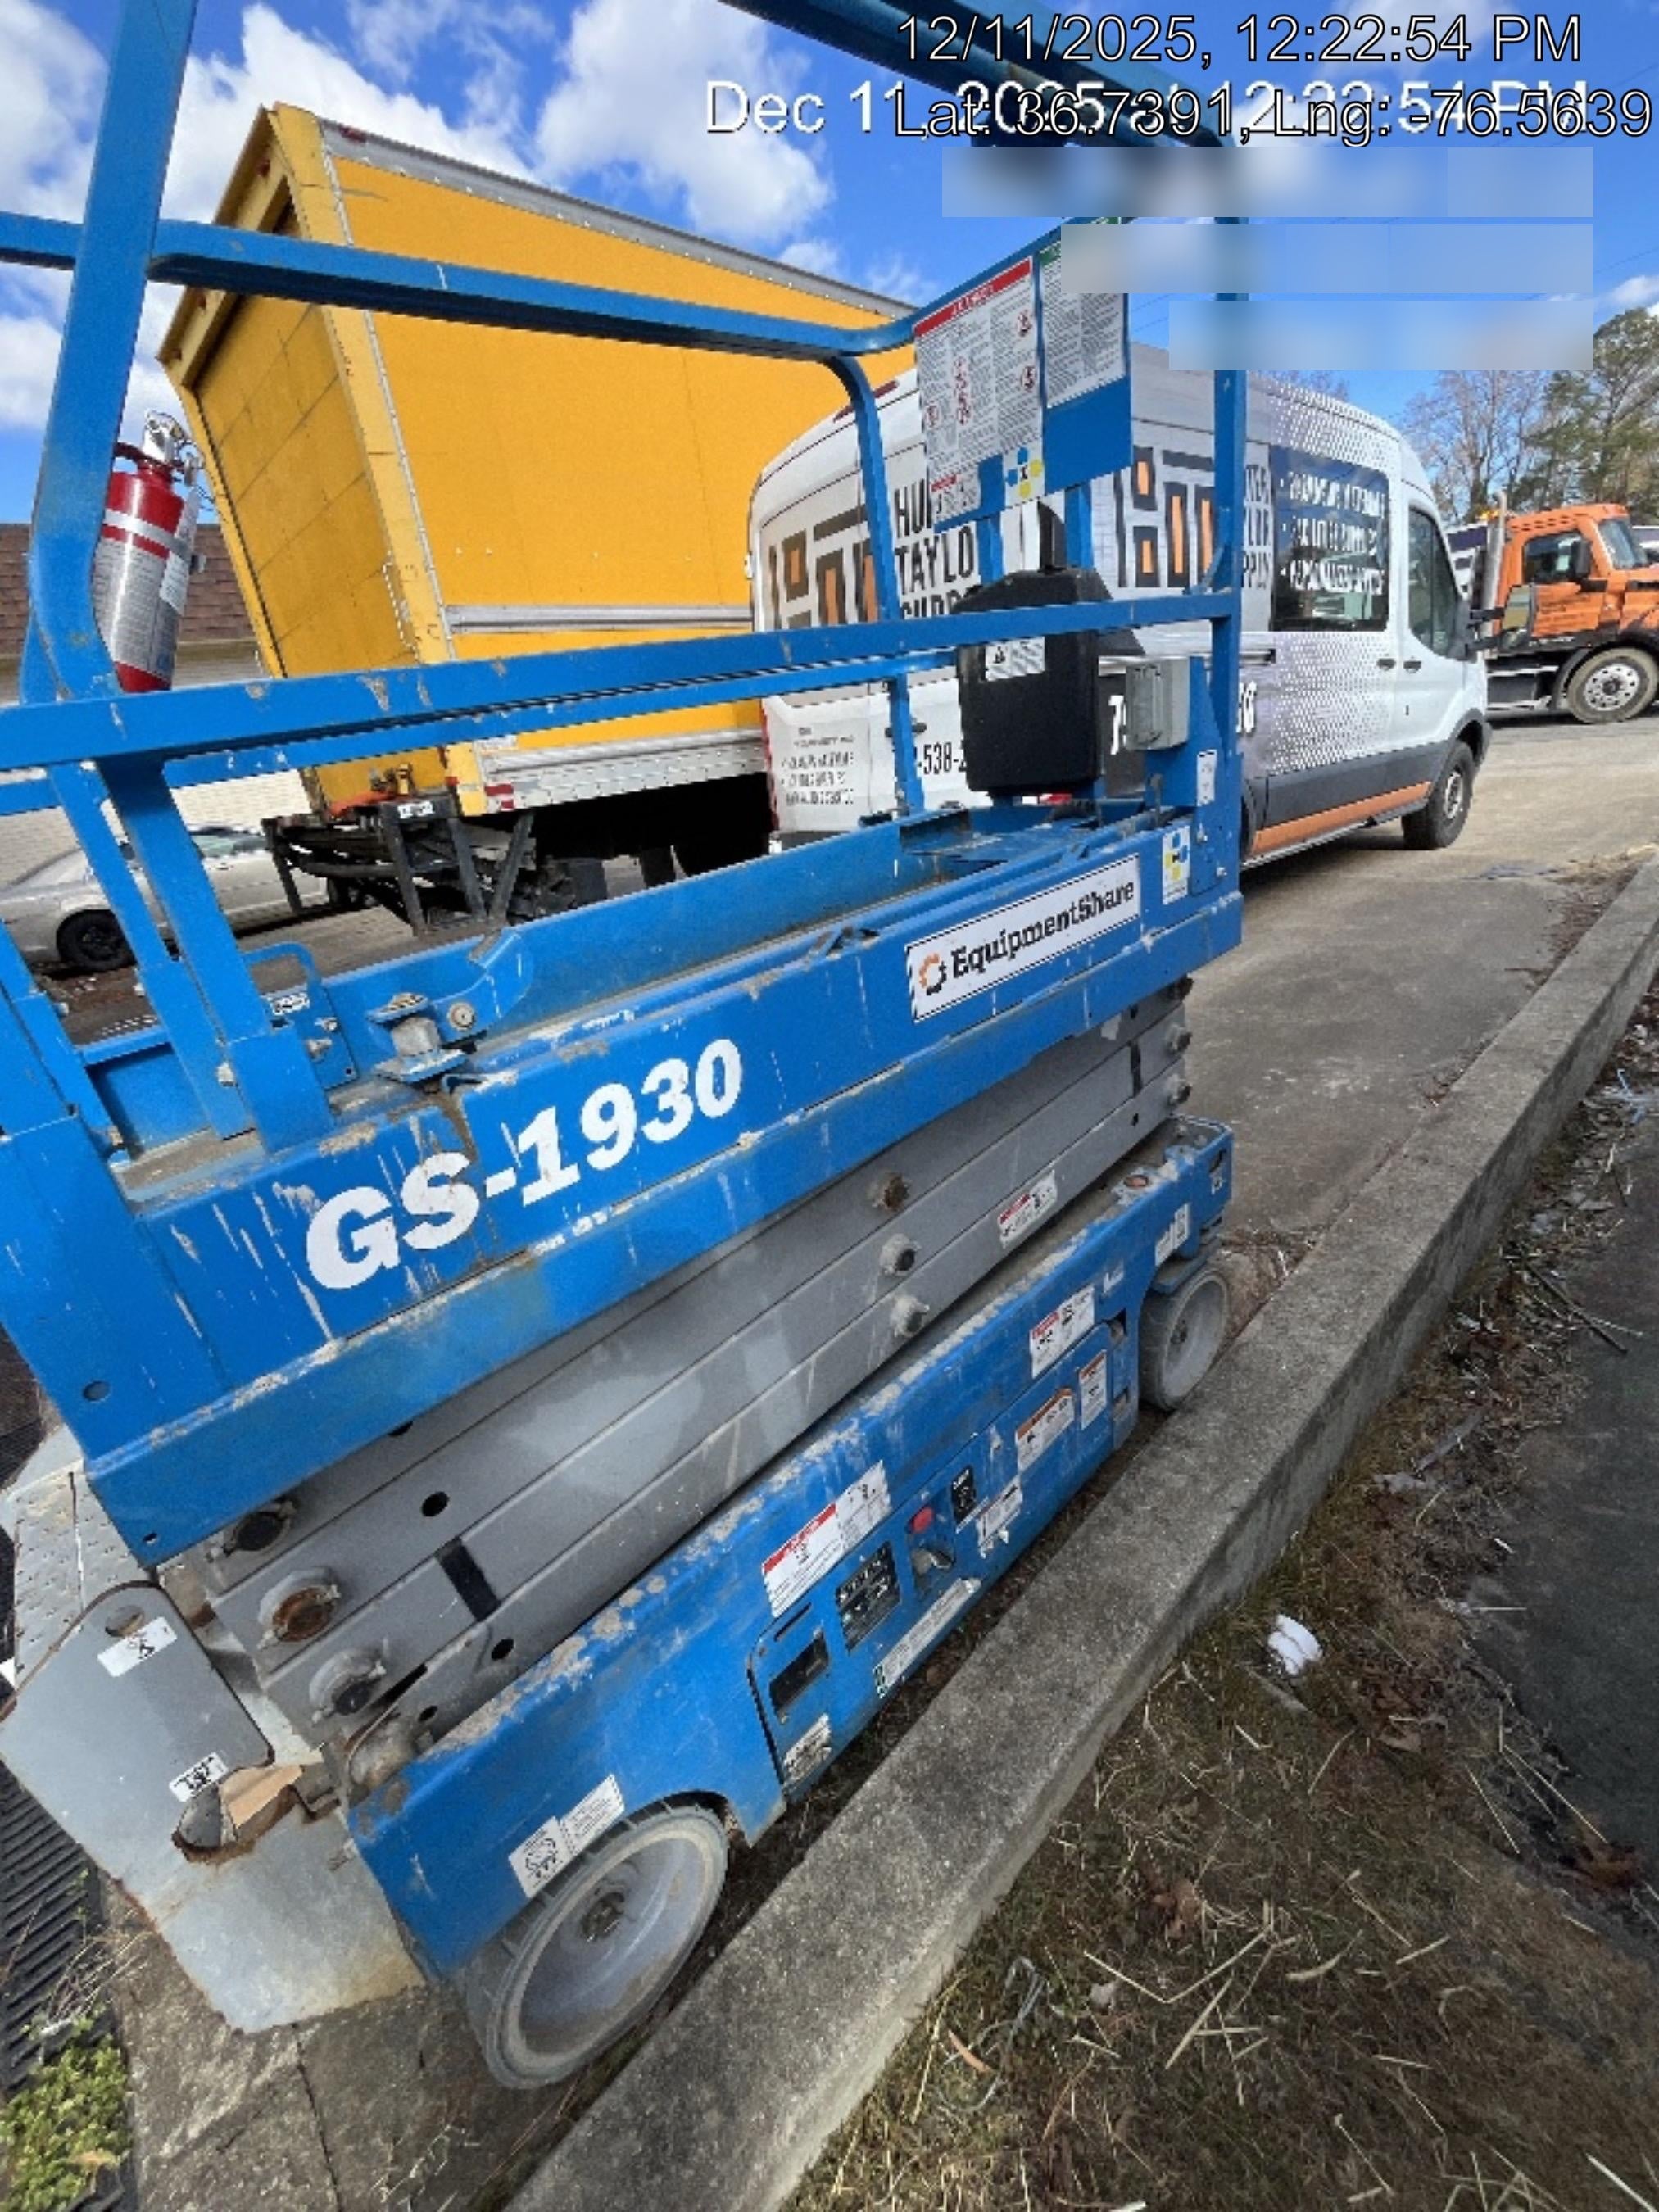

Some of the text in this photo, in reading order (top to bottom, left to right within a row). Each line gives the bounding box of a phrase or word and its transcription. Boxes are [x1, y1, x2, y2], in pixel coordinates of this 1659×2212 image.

[895, 525, 975, 595] TAYLO
[951, 881, 1135, 979] EquipmentShare
[306, 1038, 744, 1290] GS-1930
